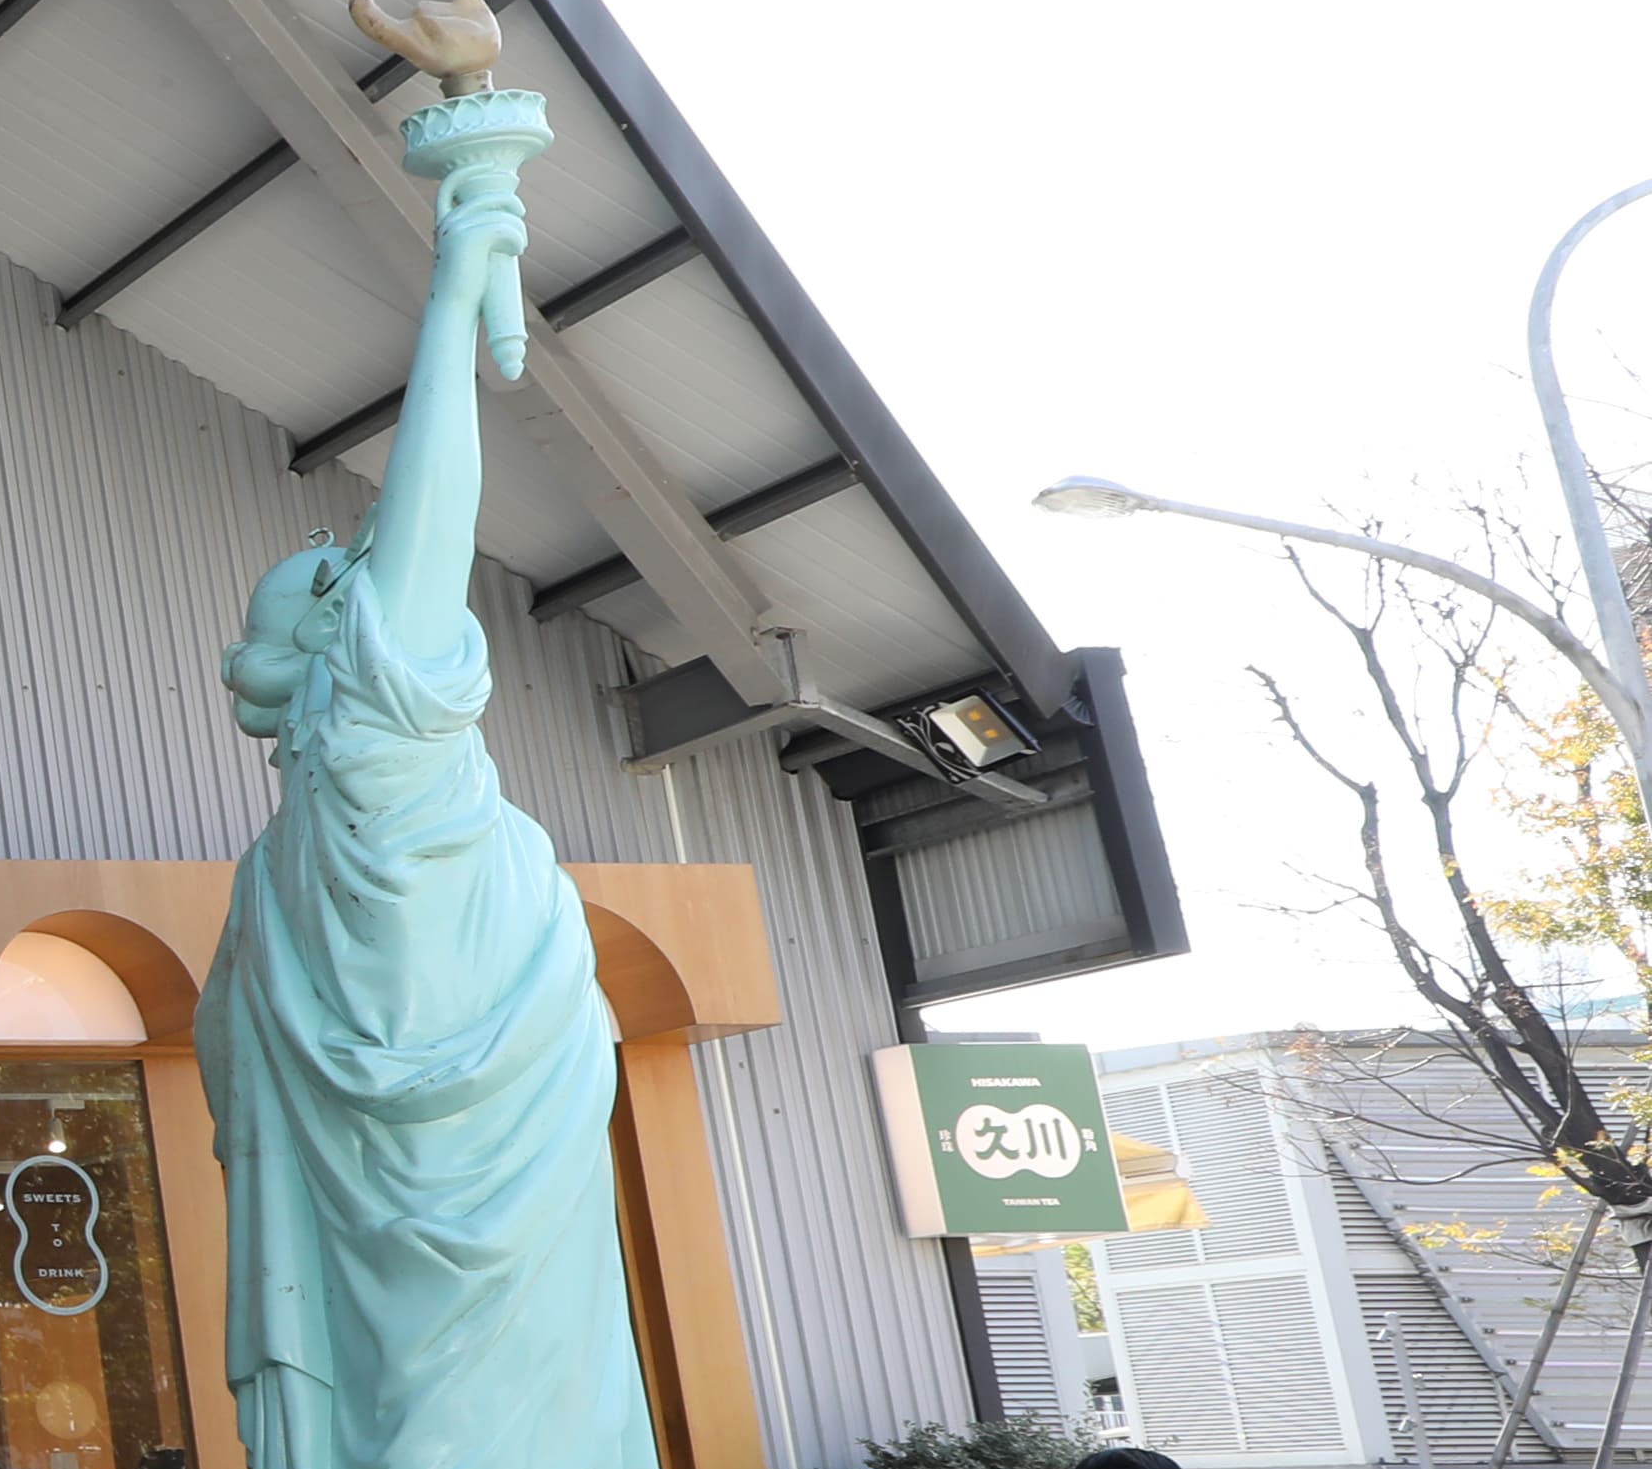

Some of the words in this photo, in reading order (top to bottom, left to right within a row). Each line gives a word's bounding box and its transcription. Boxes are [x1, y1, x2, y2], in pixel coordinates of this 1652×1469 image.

[971, 1077, 1042, 1087] HISAKAWA
[974, 1117, 1067, 1160] 久川
[23, 1193, 82, 1204] SWEETS
[39, 1268, 85, 1278] DRINK
